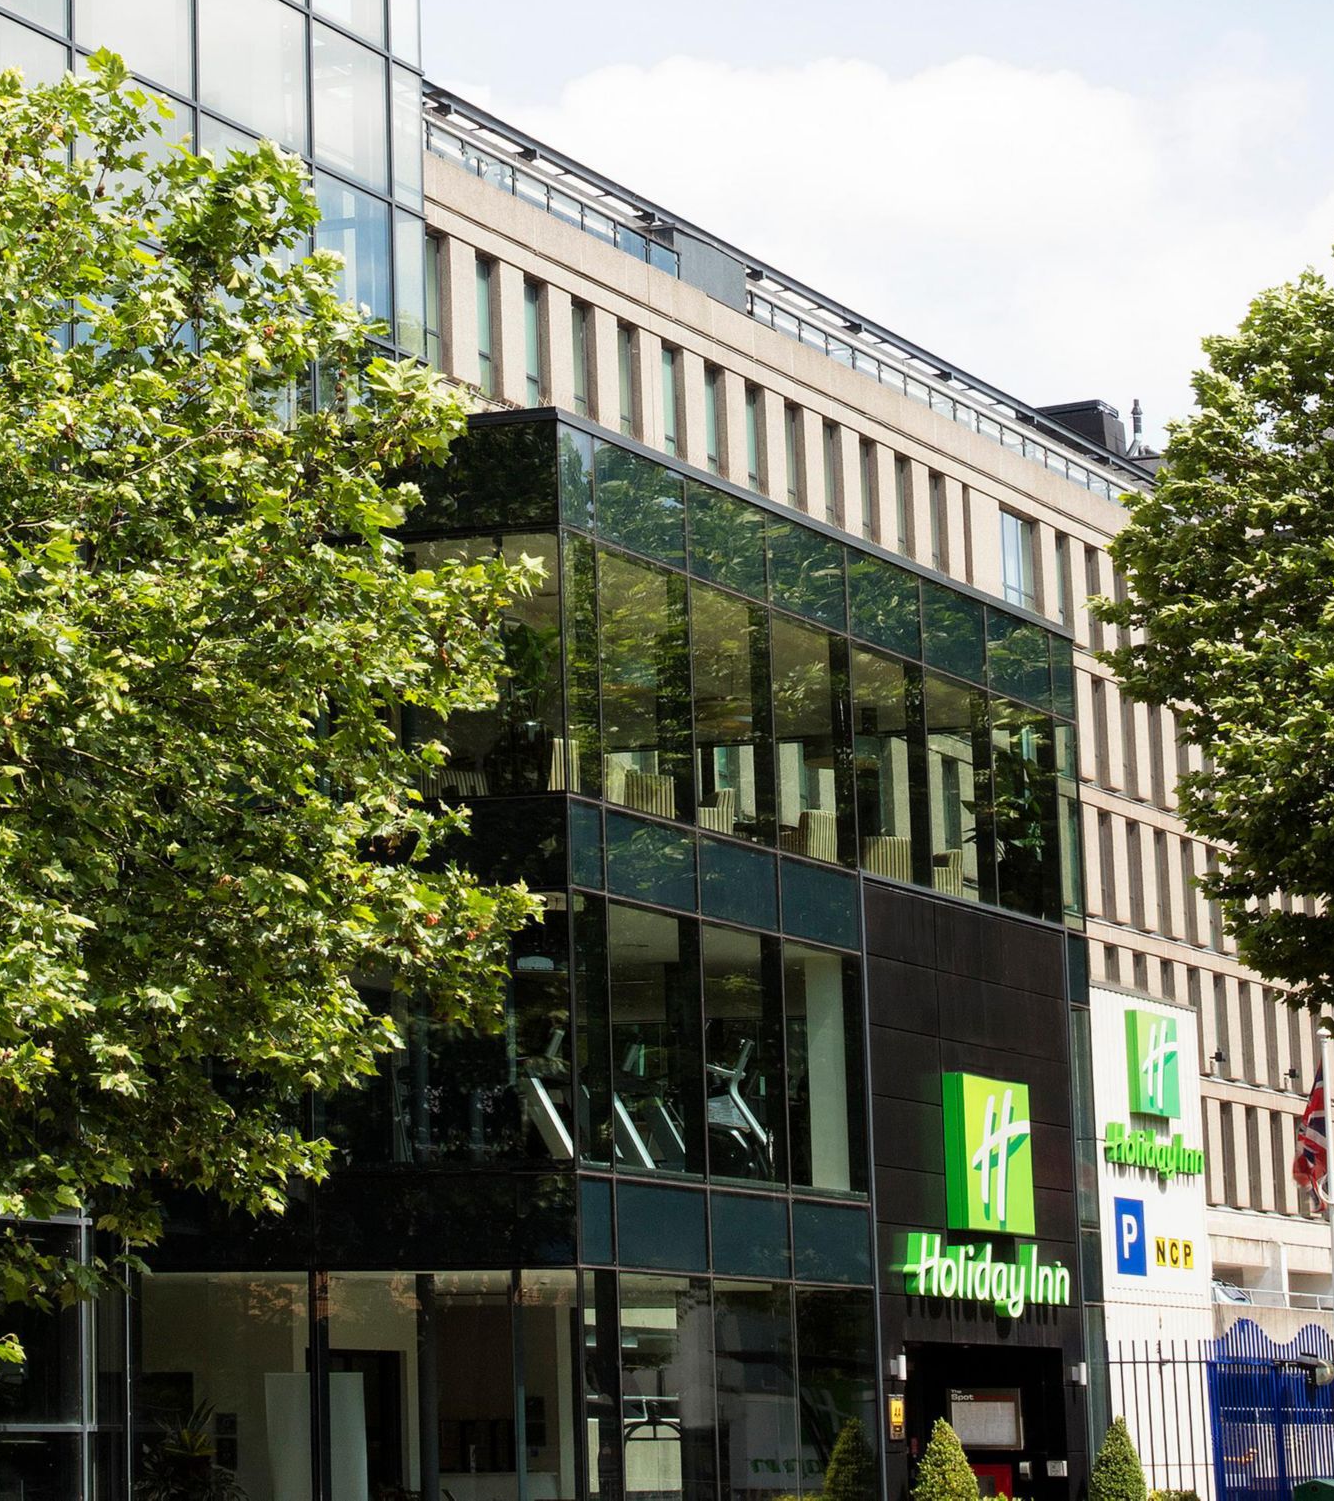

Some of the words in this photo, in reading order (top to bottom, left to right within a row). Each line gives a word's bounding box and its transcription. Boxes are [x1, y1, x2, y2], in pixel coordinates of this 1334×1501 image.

[1105, 1122, 1177, 1181] Holiday
[1174, 1133, 1205, 1176] Inn
[1121, 1213, 1138, 1260] P
[1155, 1237, 1194, 1269] NCP
[907, 1232, 1027, 1319] Holiday
[1029, 1243, 1071, 1306] Inn
[950, 1393, 975, 1401] Spot
